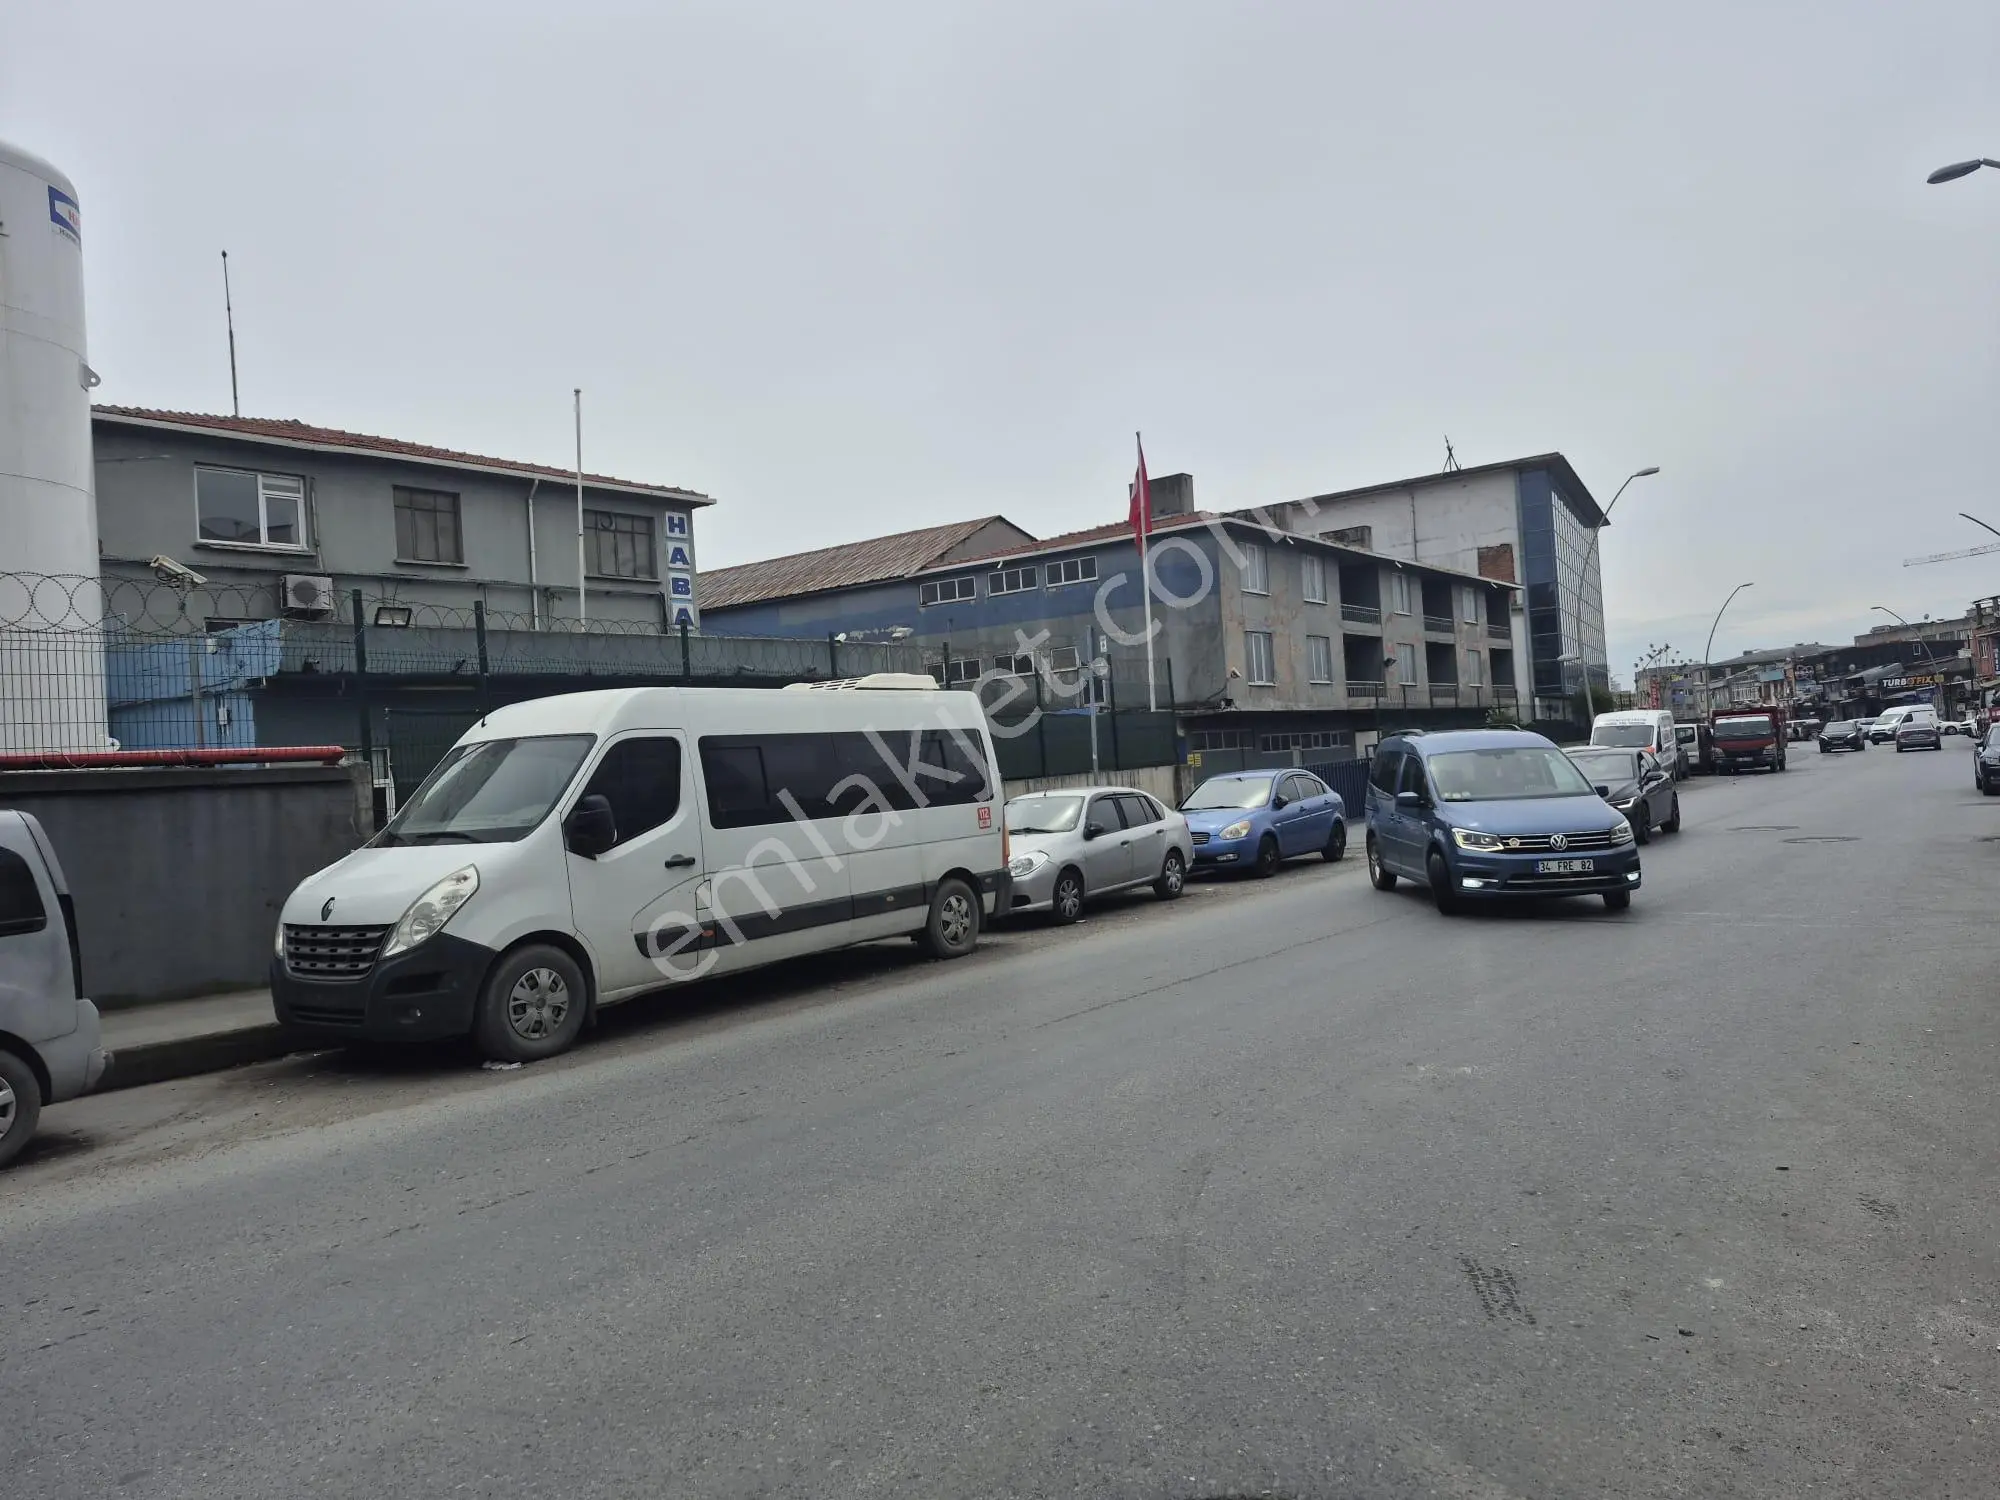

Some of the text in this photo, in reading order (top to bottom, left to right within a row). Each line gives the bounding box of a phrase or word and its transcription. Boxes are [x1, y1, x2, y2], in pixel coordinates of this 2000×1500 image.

[667, 515, 695, 626] HABA
[1540, 860, 1592, 872] 34 FRE 82
